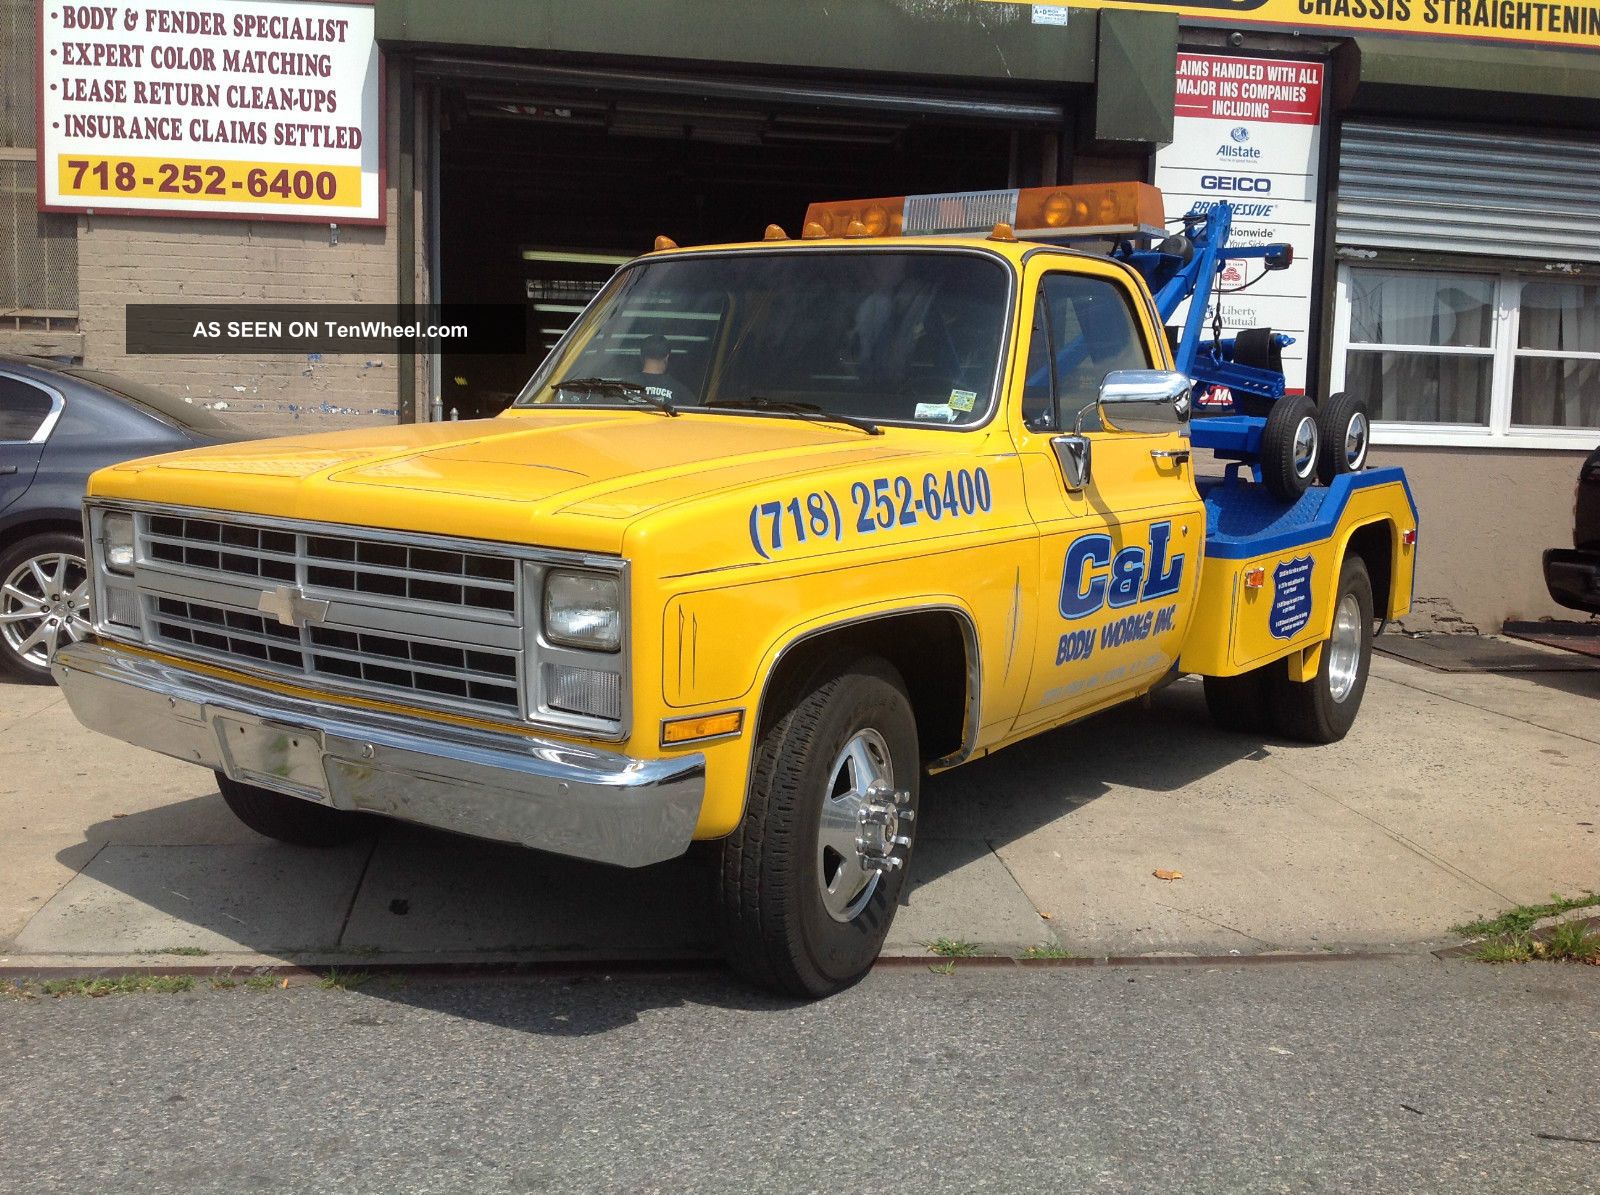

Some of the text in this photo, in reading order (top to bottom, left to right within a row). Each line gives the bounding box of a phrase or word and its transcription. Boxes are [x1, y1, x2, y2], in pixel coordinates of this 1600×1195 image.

[62, 5, 348, 43] BODY & FENDER SPECIALIST
[62, 42, 332, 77] EXPERT COLOR MATCHING
[1212, 62, 1264, 81] HANDLED
[1267, 66, 1296, 83] WITH
[1298, 69, 1319, 84] ALL
[62, 78, 337, 113] LEASE RETURN CLEAN-UPS
[1176, 78, 1307, 103] MAJOR INS COMPANIES
[1212, 100, 1270, 119] INCLUDING
[64, 114, 362, 150] INSURANCE CLAIMS SETTLED
[1216, 145, 1261, 158] Allstate
[68, 160, 337, 200] 718-252-6400
[1200, 175, 1271, 192] GEICO
[1221, 306, 1257, 316] Liberty
[645, 386, 673, 399] TRUCK
[749, 466, 992, 560] (718) 252-6400
[1058, 520, 1185, 620] C&L
[1055, 628, 1097, 666] BODY
[1100, 610, 1154, 650] WORKS
